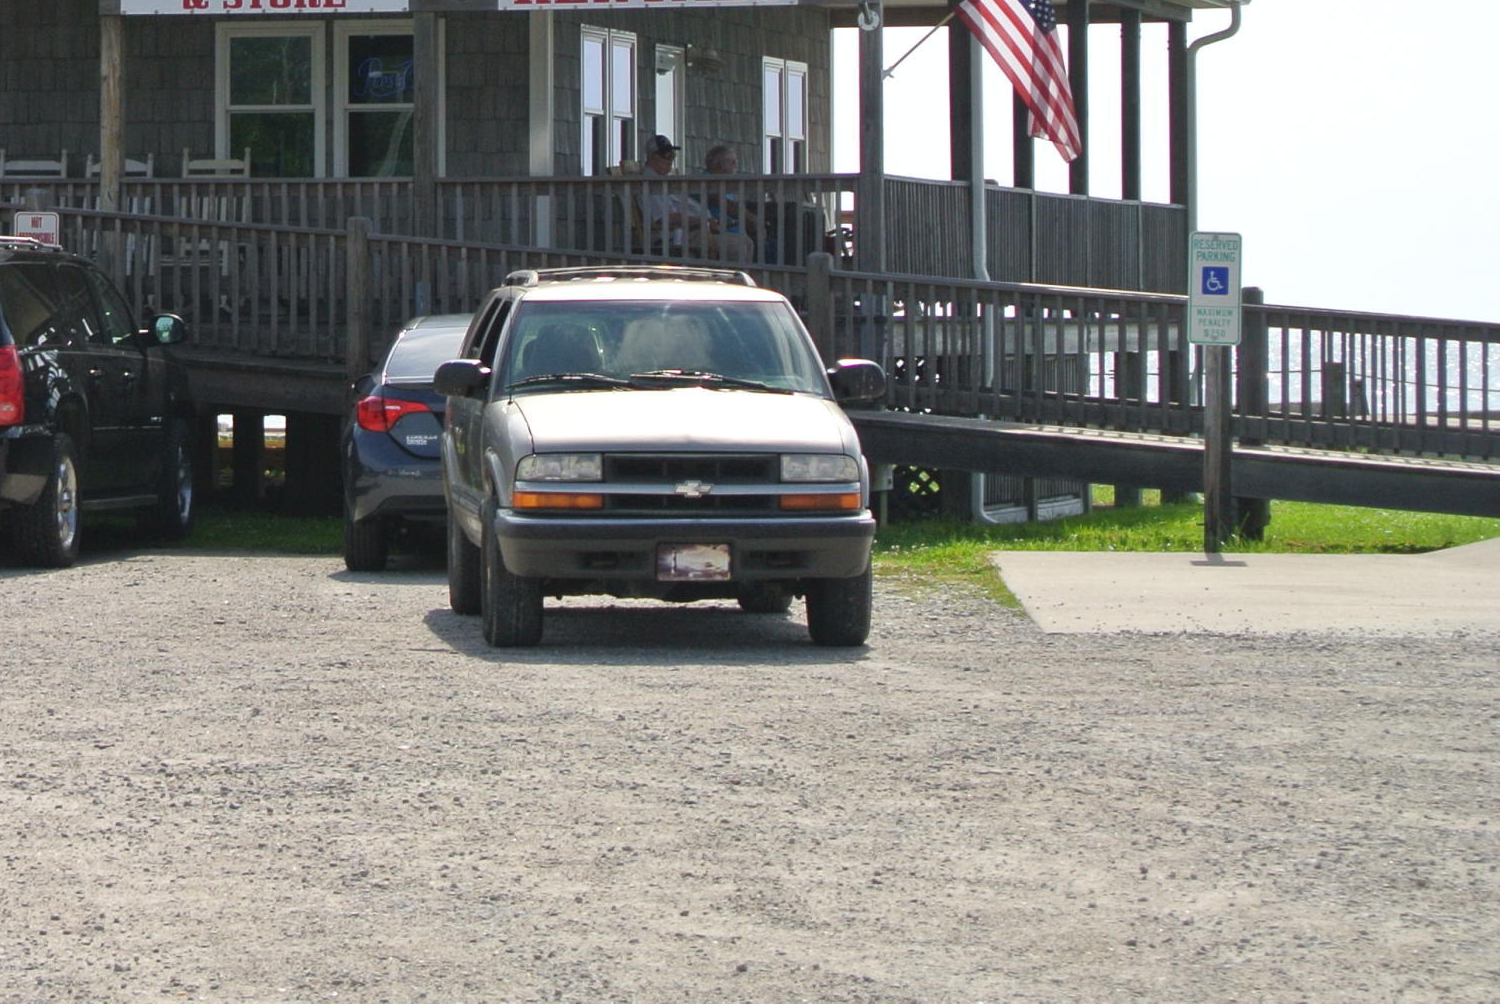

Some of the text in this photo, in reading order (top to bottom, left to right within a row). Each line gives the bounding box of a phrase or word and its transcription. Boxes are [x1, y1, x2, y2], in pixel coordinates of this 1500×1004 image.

[1193, 239, 1238, 251] RESERVED
[1196, 251, 1236, 262] PARKING
[1197, 308, 1233, 316] MAXIMUM
[1198, 318, 1231, 327] PENALTY
